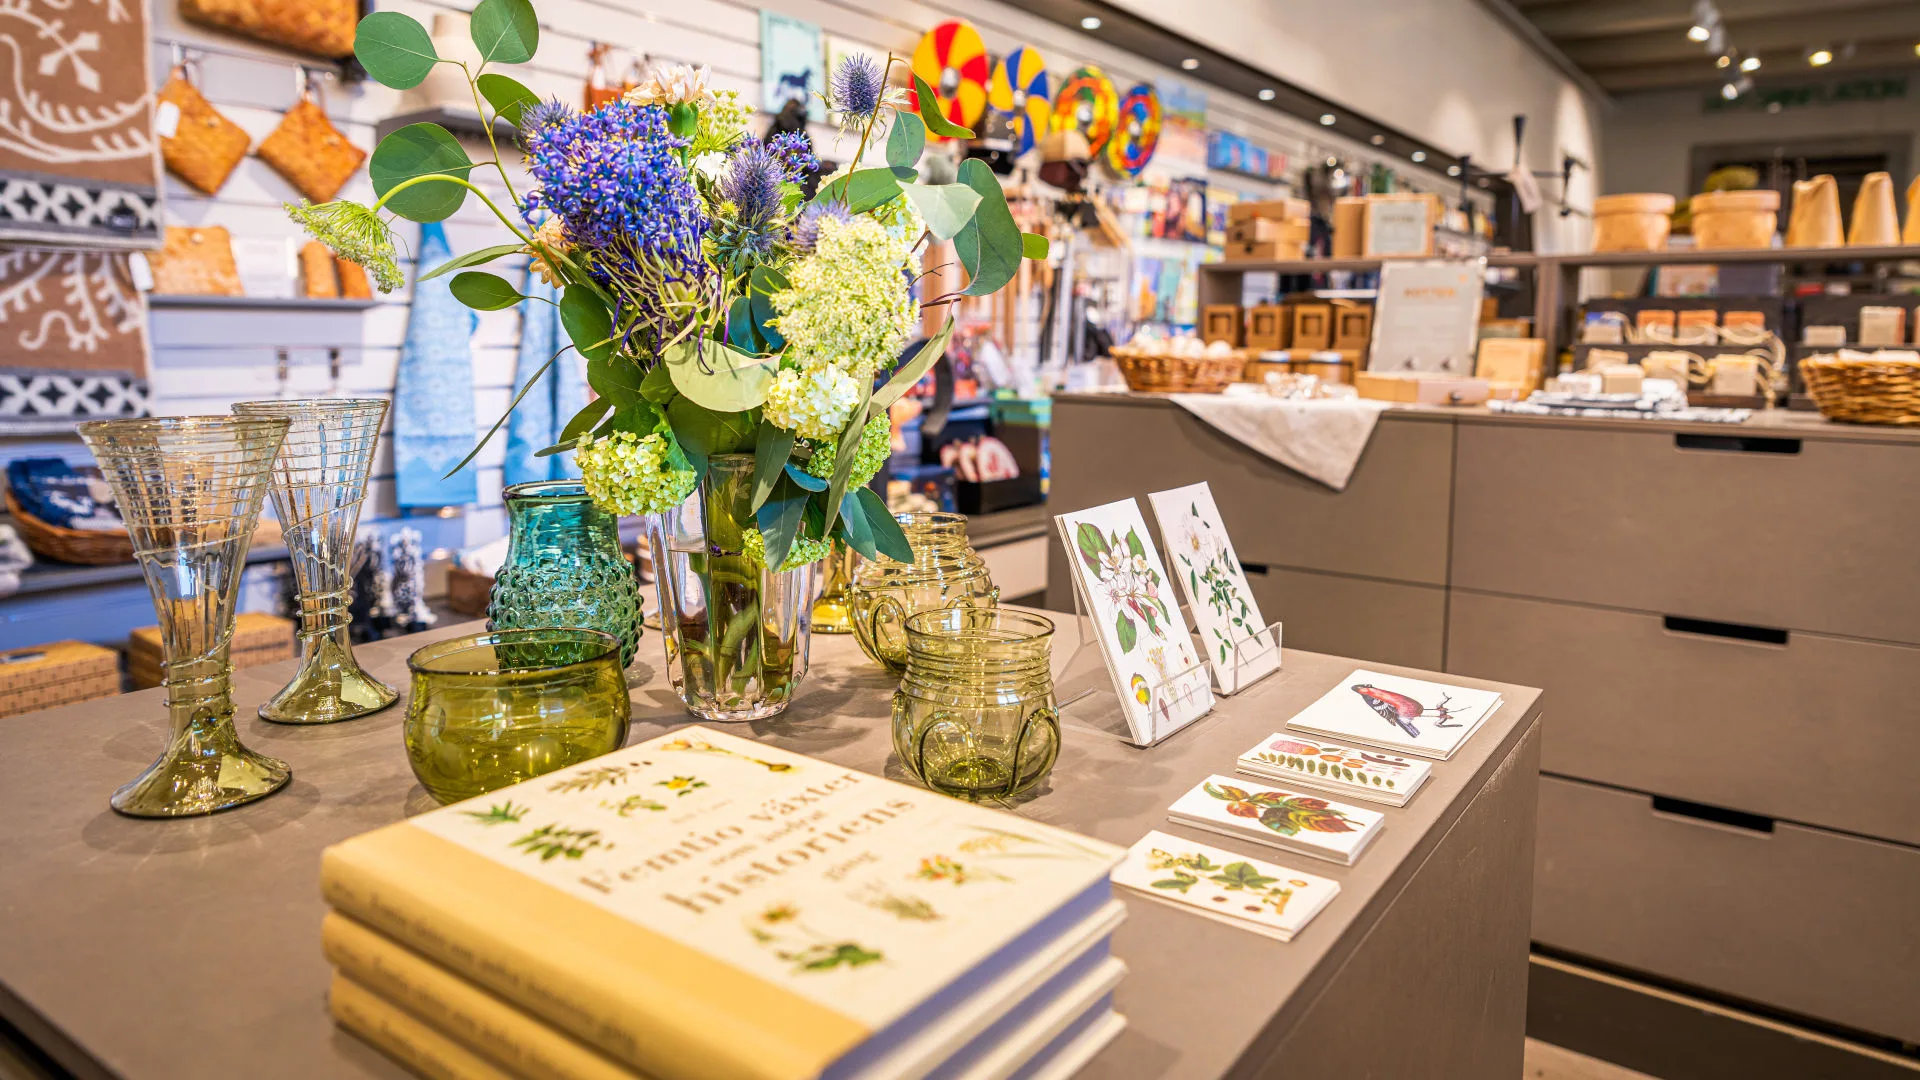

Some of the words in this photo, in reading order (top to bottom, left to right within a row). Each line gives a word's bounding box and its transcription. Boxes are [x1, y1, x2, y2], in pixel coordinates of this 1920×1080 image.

[578, 825, 744, 895] Femtio
[748, 773, 864, 823] växter
[662, 798, 916, 914] historiens
